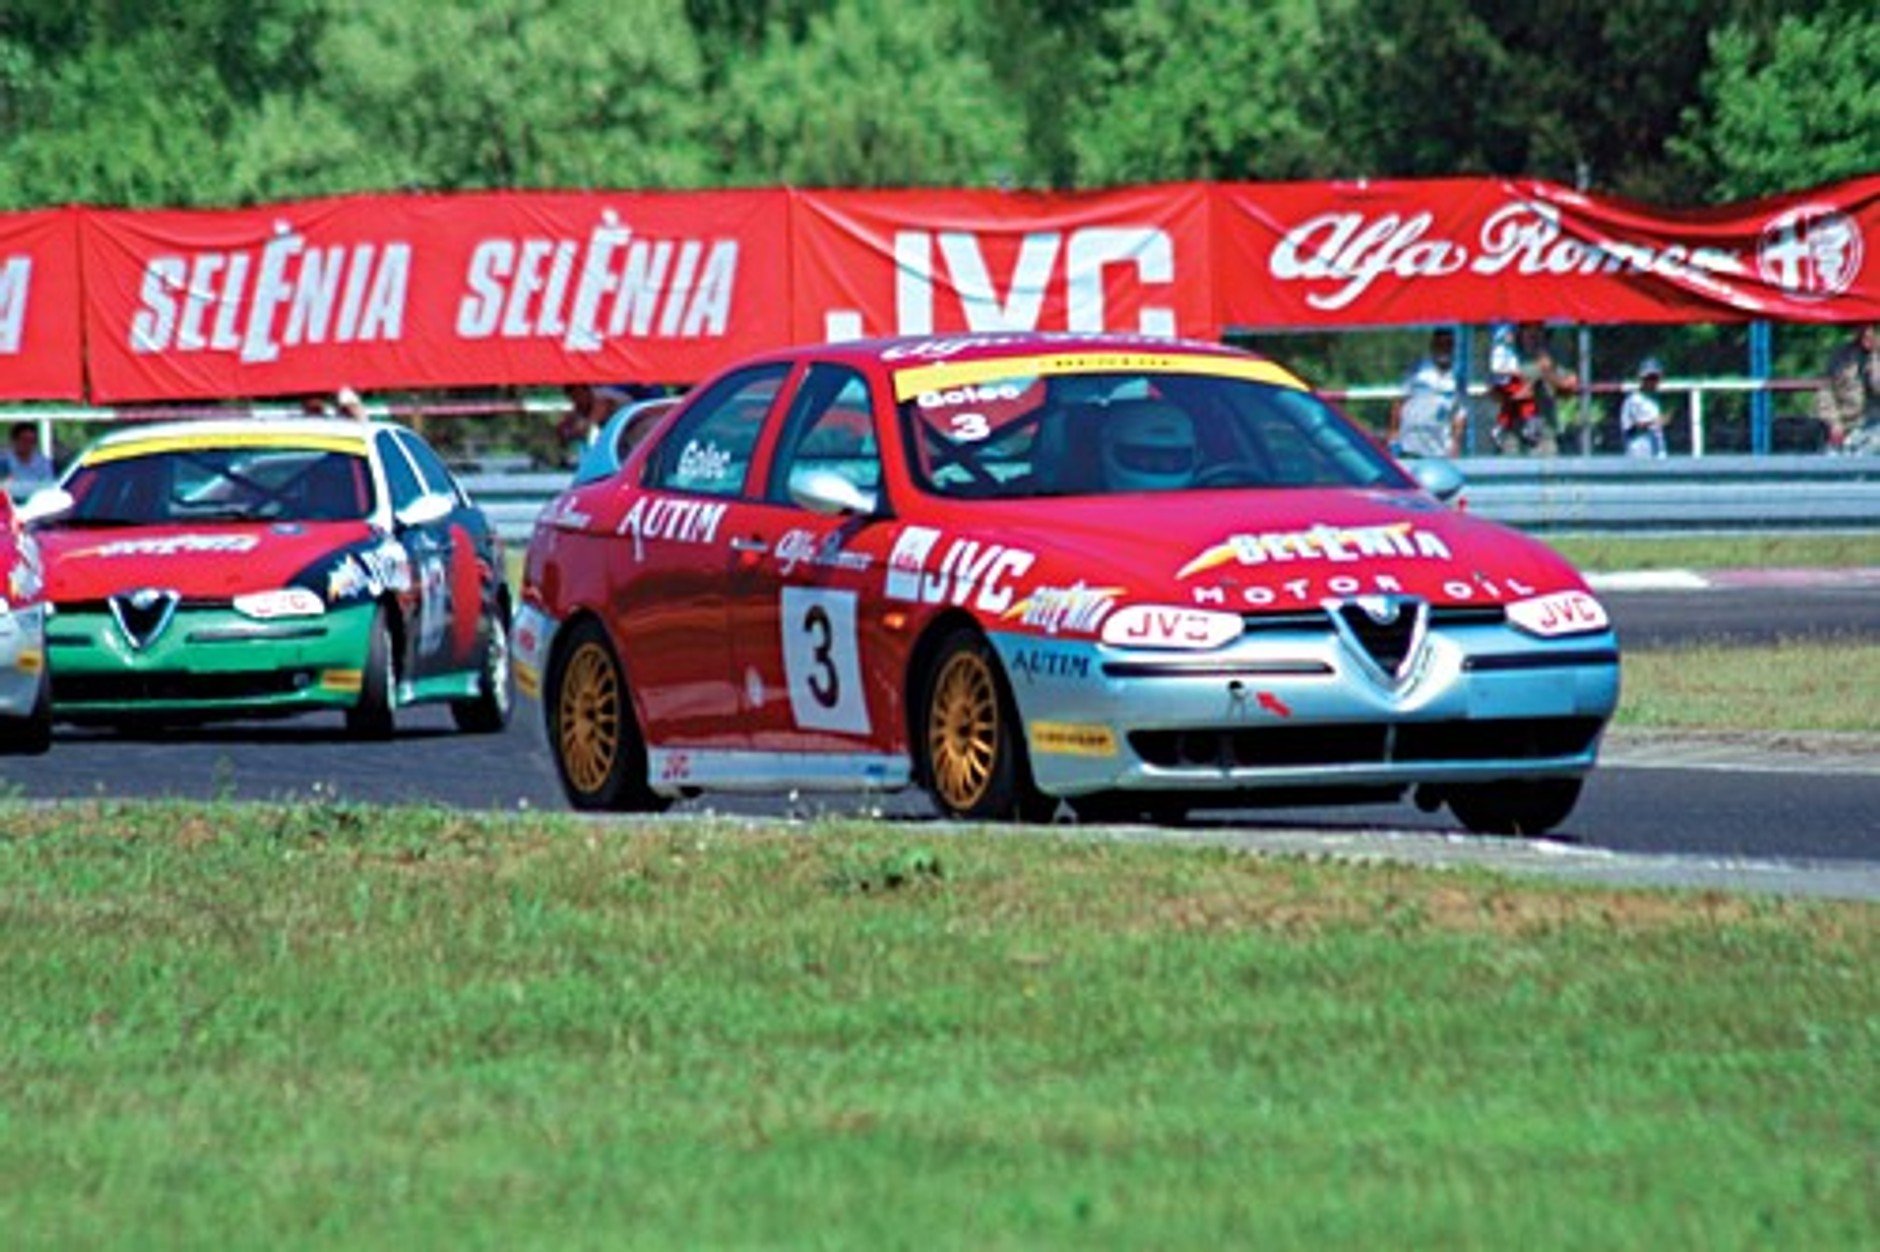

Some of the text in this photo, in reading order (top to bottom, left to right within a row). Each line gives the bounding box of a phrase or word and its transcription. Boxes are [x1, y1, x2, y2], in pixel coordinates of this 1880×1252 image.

[825, 226, 1176, 339] JVC
[1269, 210, 1467, 310] Alfa
[951, 413, 991, 441] 3
[617, 497, 727, 562] AUTIM
[924, 538, 1036, 613] JVC
[1193, 574, 1535, 604] MOTOR OIL
[1541, 596, 1596, 628] JVC
[804, 604, 840, 708] 3
[1012, 649, 1091, 685] AUTIM
